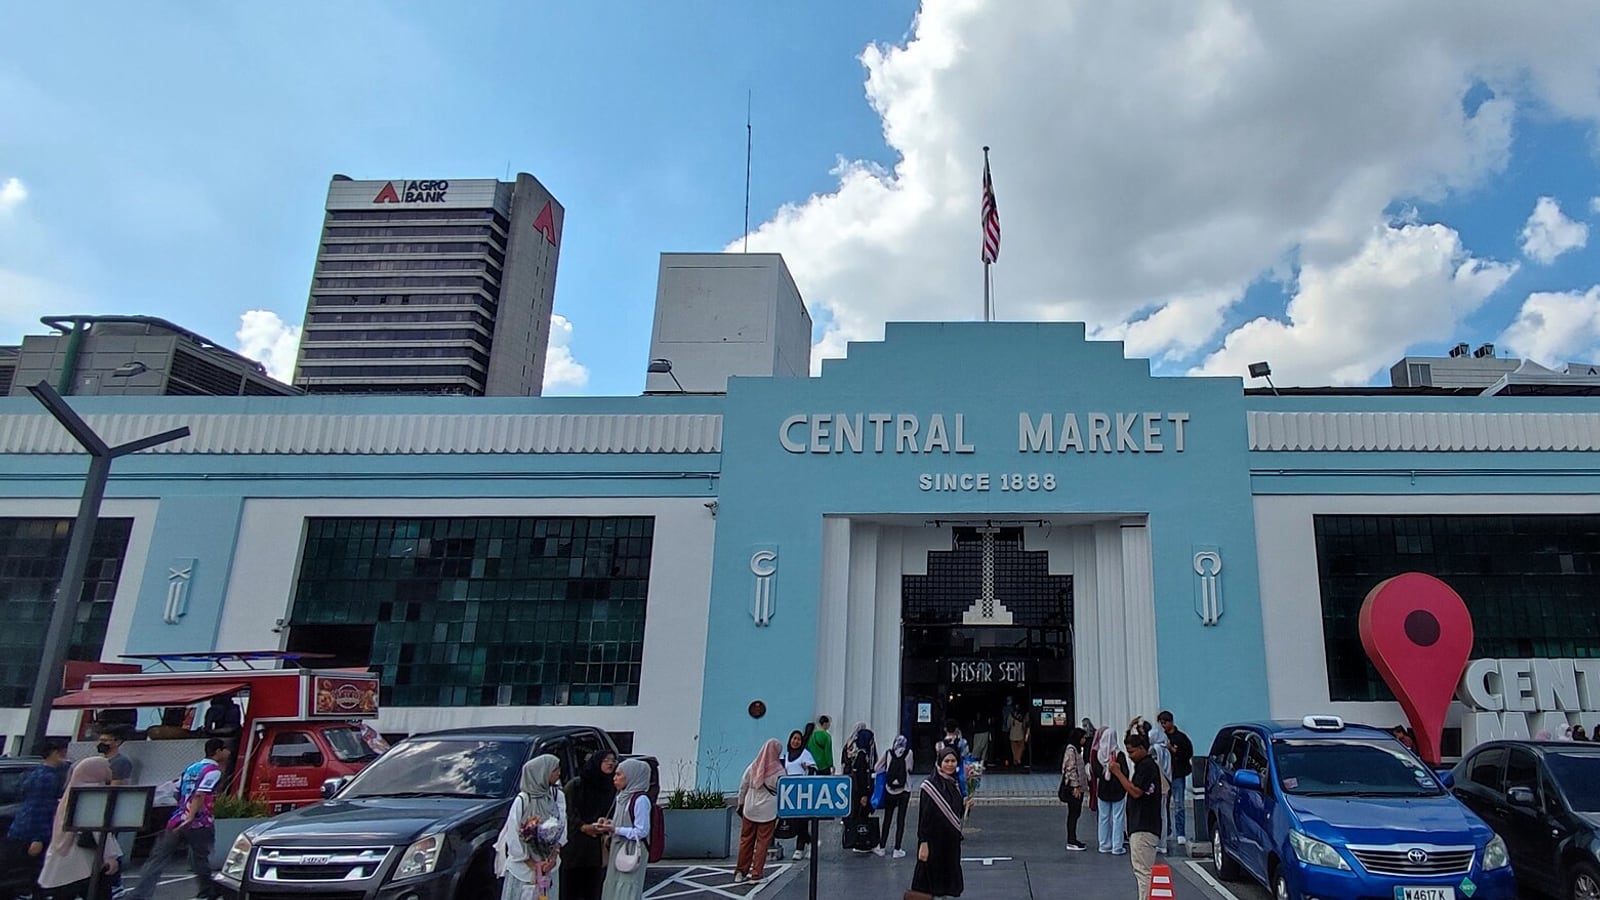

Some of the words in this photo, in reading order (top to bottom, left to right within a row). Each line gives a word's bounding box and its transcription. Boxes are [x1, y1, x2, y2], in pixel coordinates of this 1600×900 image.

[407, 180, 449, 191] AGRO
[405, 191, 447, 203] BANK
[778, 413, 976, 454] CENTRAL
[1018, 412, 1190, 453] MARKET
[919, 473, 990, 491] SINCE
[1000, 473, 1057, 491] 1888
[951, 662, 993, 682] PASAR
[780, 783, 849, 810] KHAS
